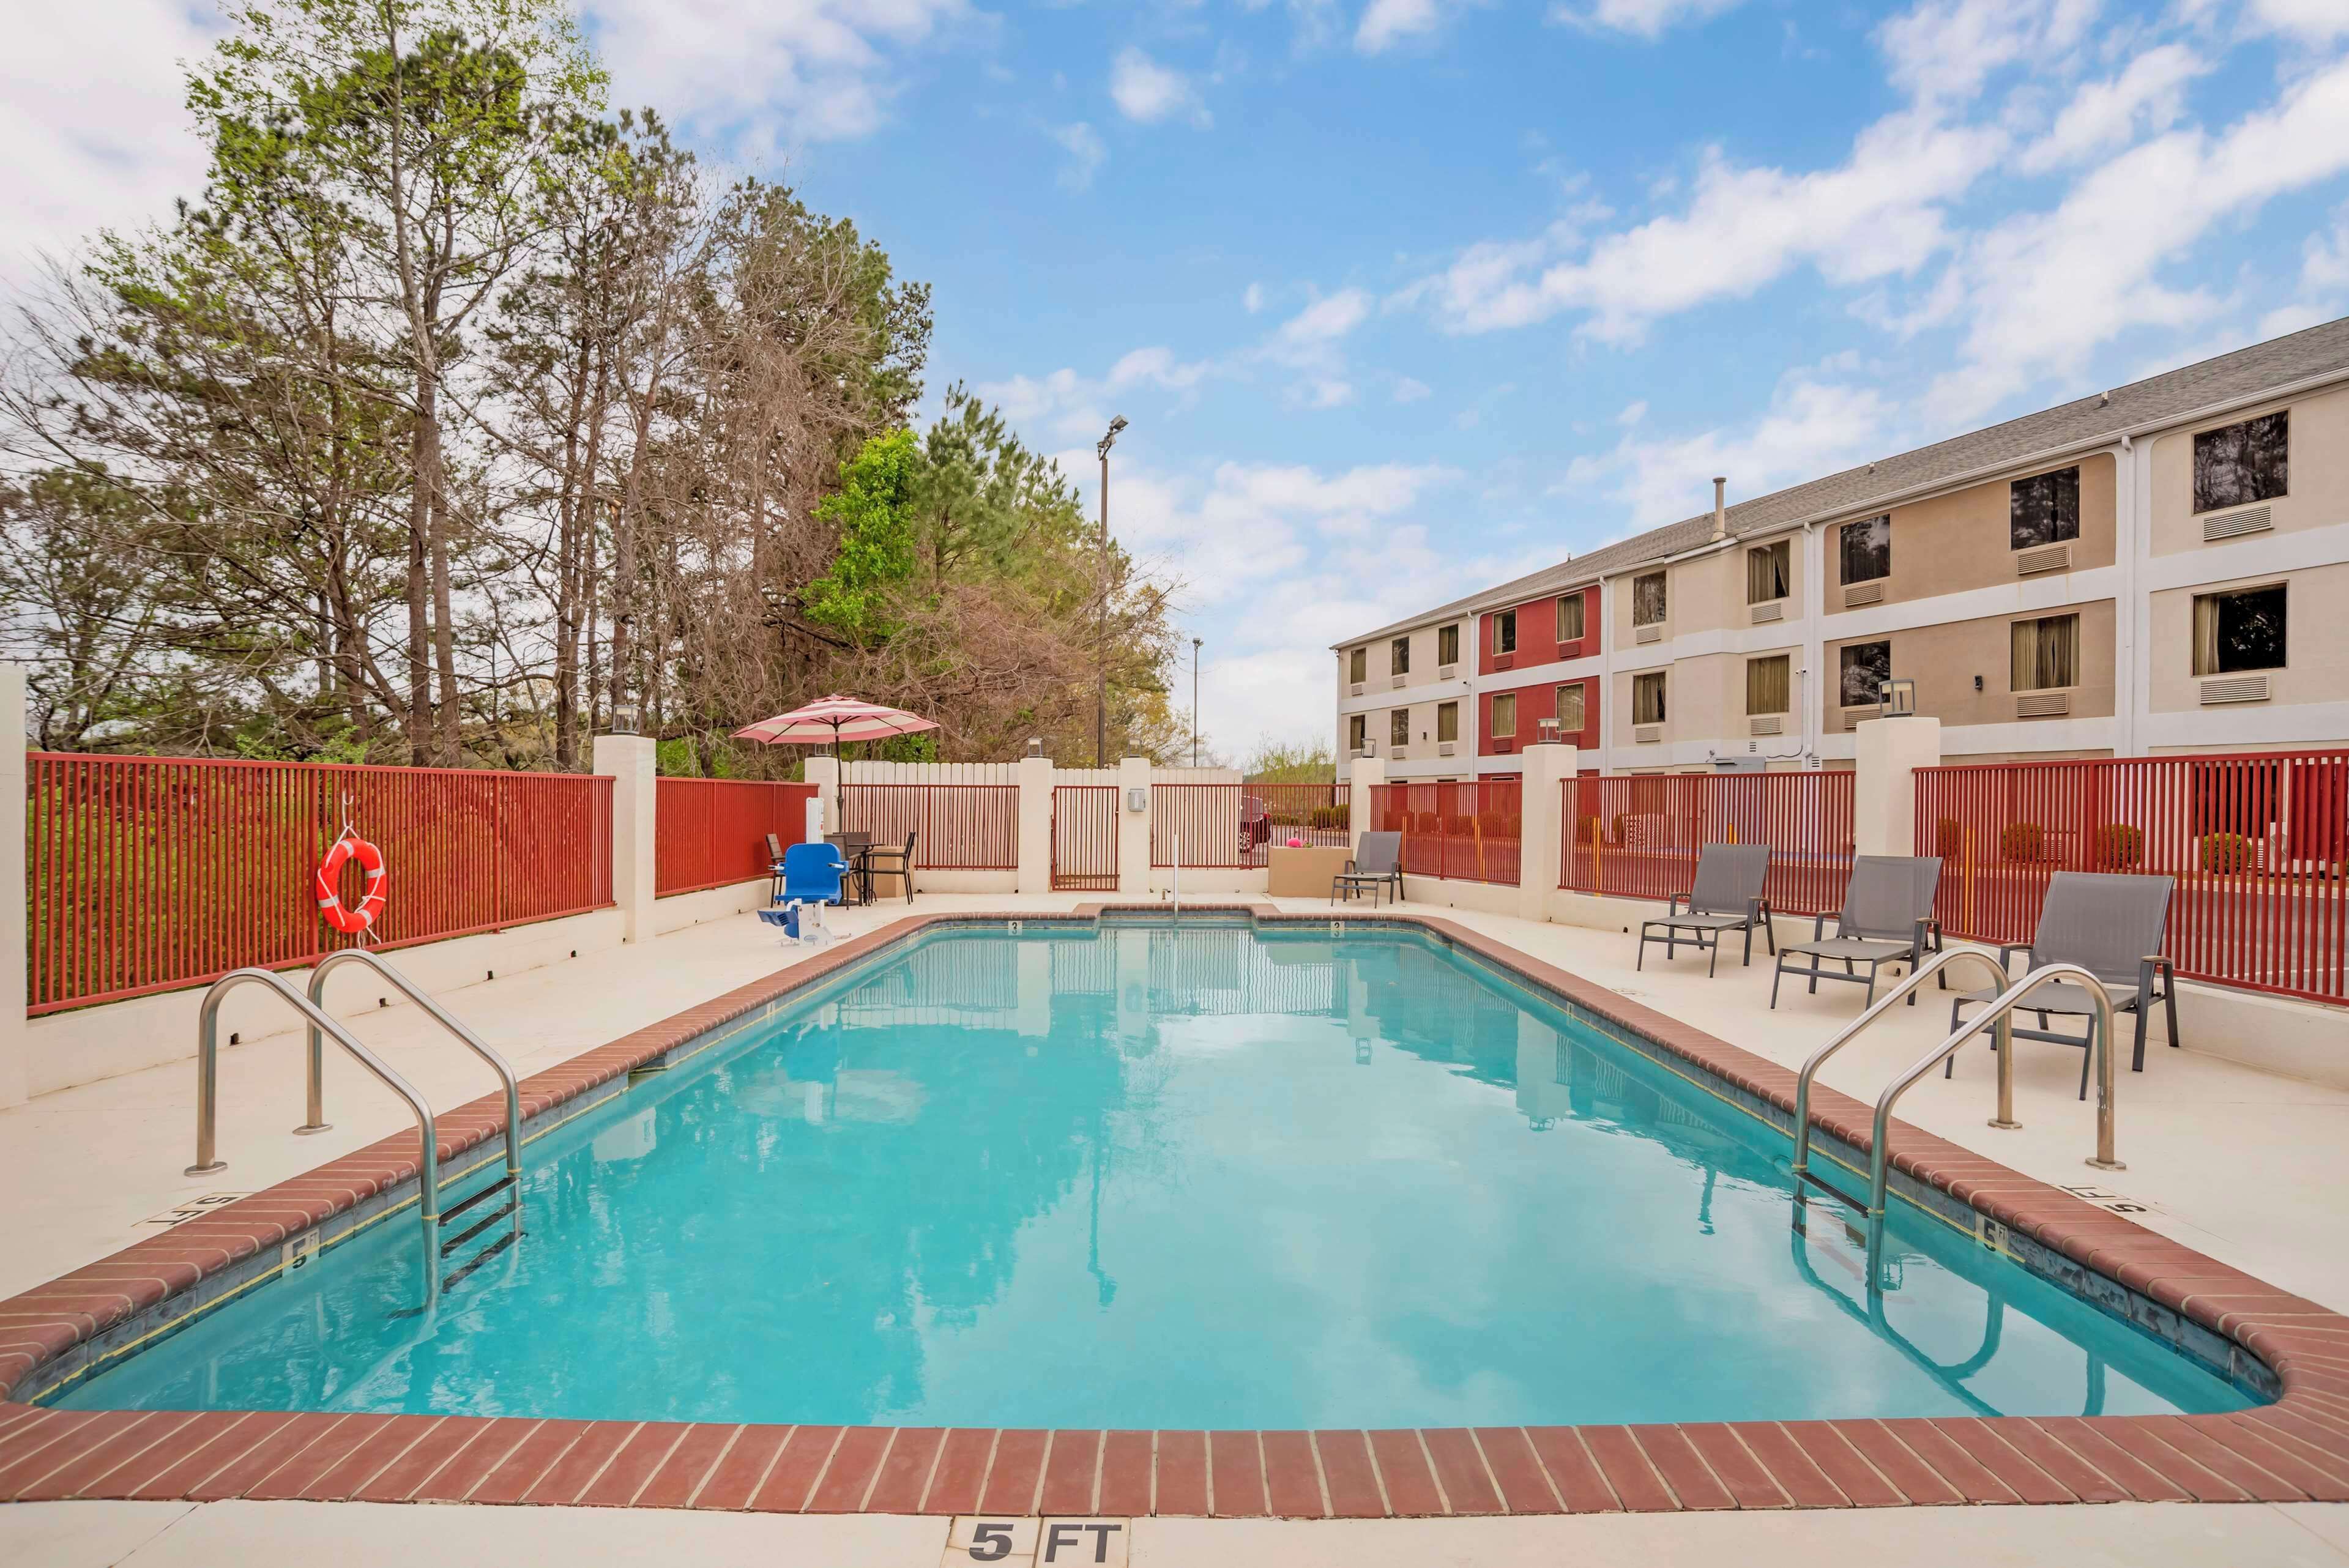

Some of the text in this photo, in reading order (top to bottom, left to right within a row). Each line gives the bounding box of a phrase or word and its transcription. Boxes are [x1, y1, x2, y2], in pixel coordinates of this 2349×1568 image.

[2058, 1185, 2117, 1198] FT
[146, 1209, 206, 1225] FT
[1984, 1218, 2006, 1252] 5 FT
[292, 1238, 307, 1268] 5
[969, 1523, 1123, 1563] 5 FT
